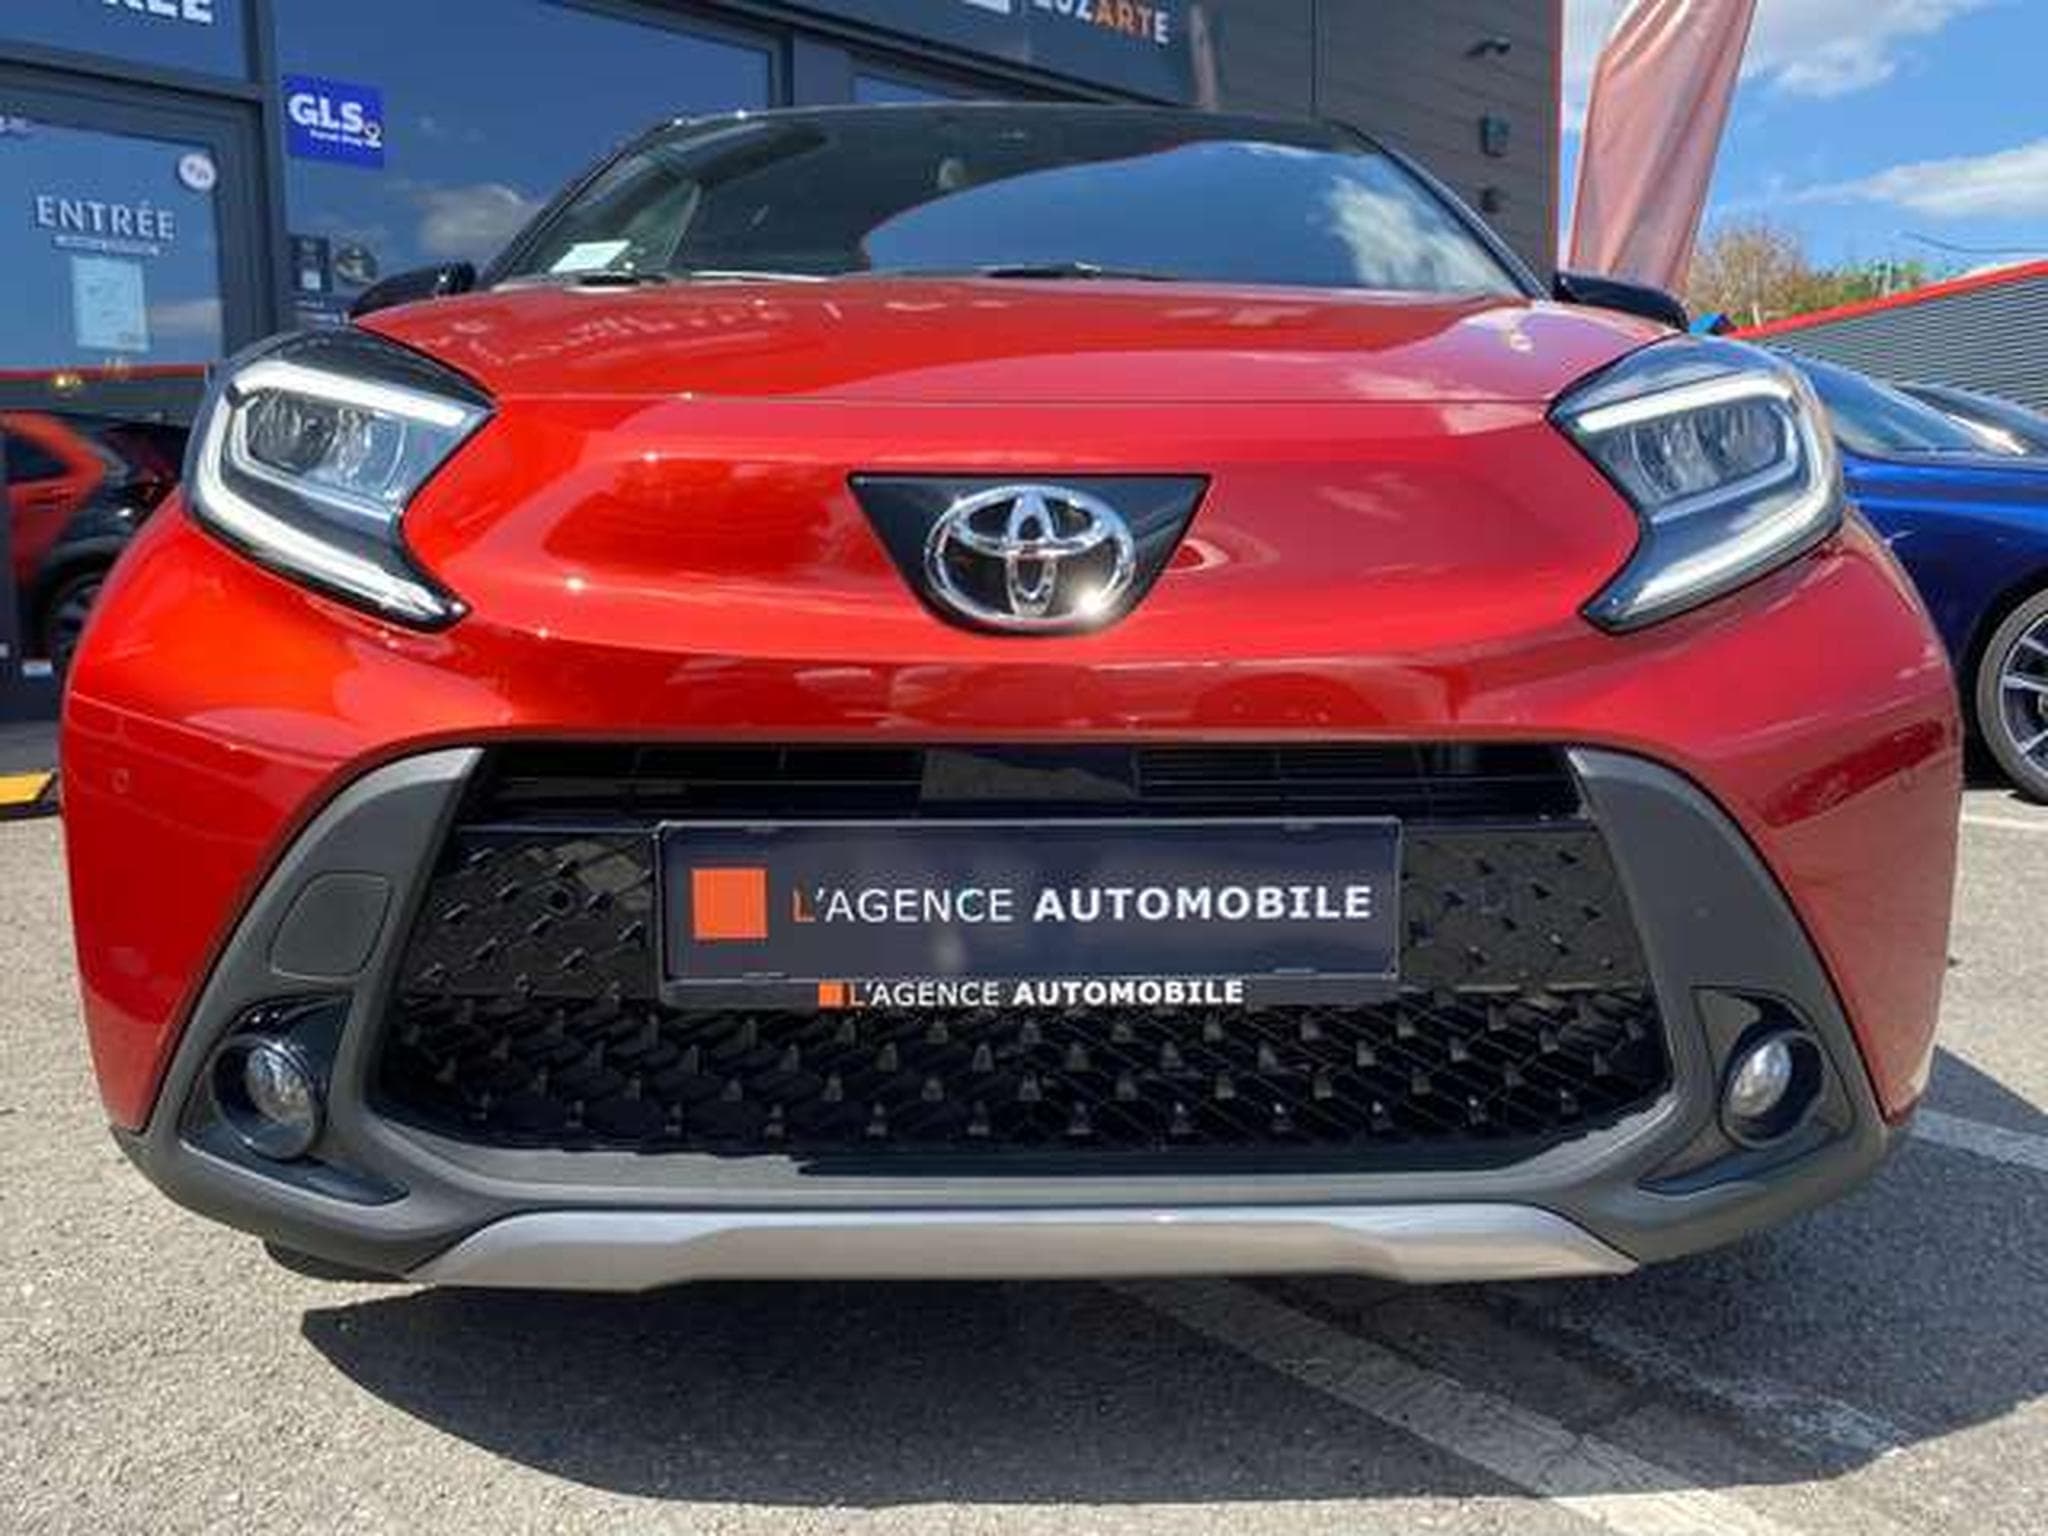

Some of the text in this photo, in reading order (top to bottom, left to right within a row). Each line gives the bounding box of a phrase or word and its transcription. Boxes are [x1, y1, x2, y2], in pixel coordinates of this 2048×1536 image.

[288, 93, 363, 134] GLS
[36, 195, 174, 240] ENTRÉE
[792, 886, 1372, 922] L'AGENCE AUTOMOBILE
[849, 980, 1244, 1006] L'AGENCE AUTOMOBILE
